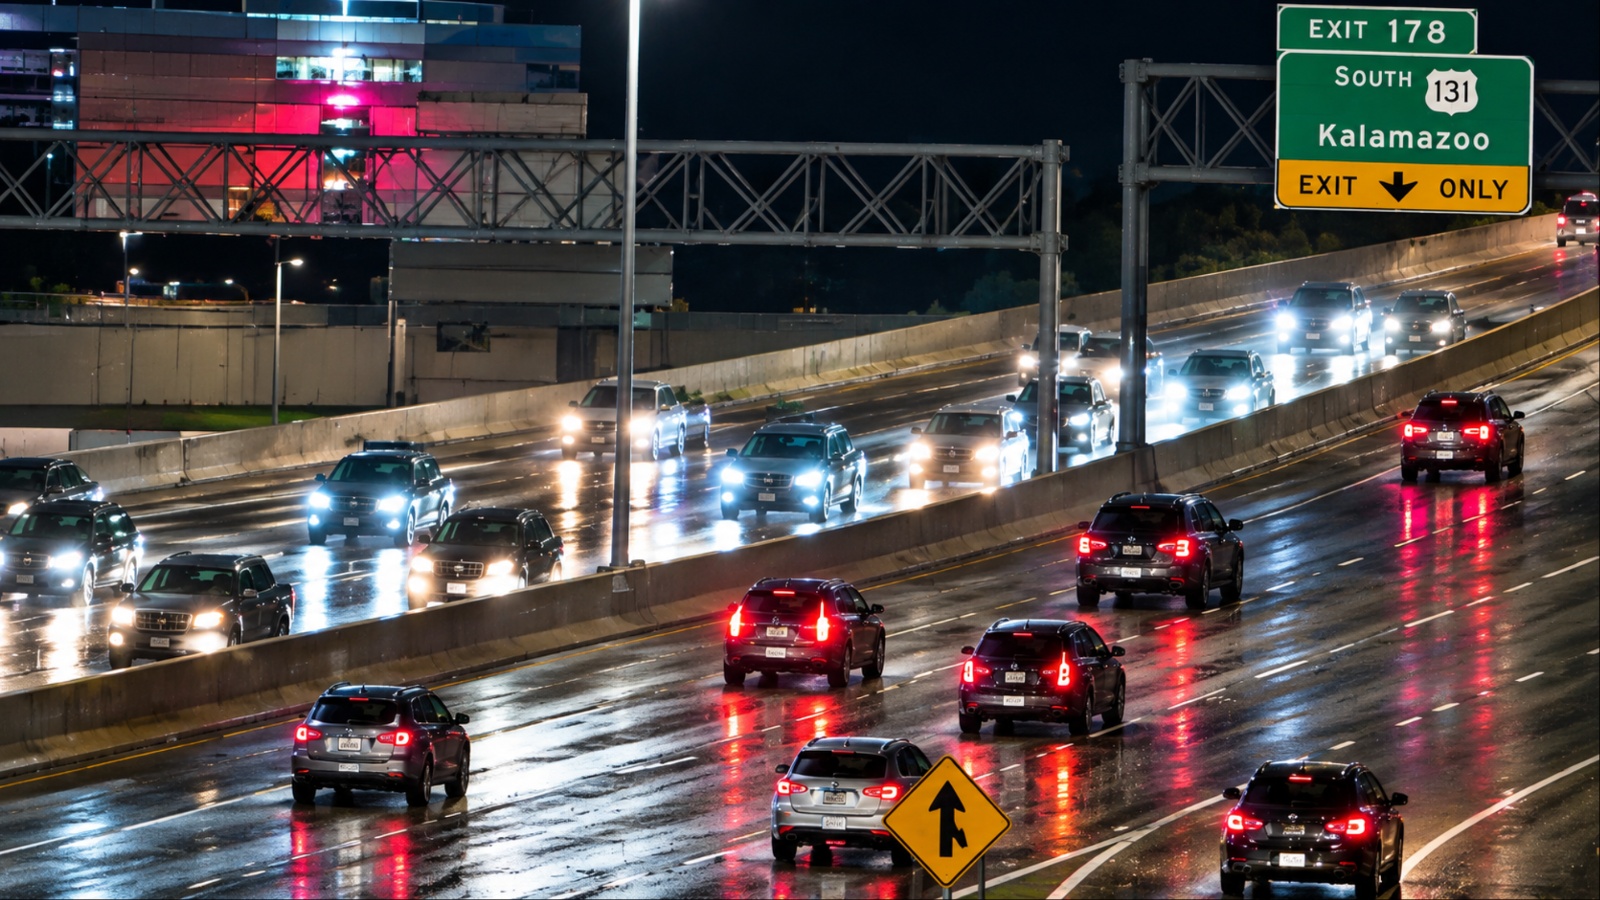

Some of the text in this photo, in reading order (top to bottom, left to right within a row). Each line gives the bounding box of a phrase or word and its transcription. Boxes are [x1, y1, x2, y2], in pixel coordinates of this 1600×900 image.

[1309, 19, 1446, 44] EXIT 178
[1334, 65, 1469, 103] SOUTH 131
[1319, 124, 1490, 151] Kalamazoo
[1299, 175, 1509, 200] EXIT ONLY
